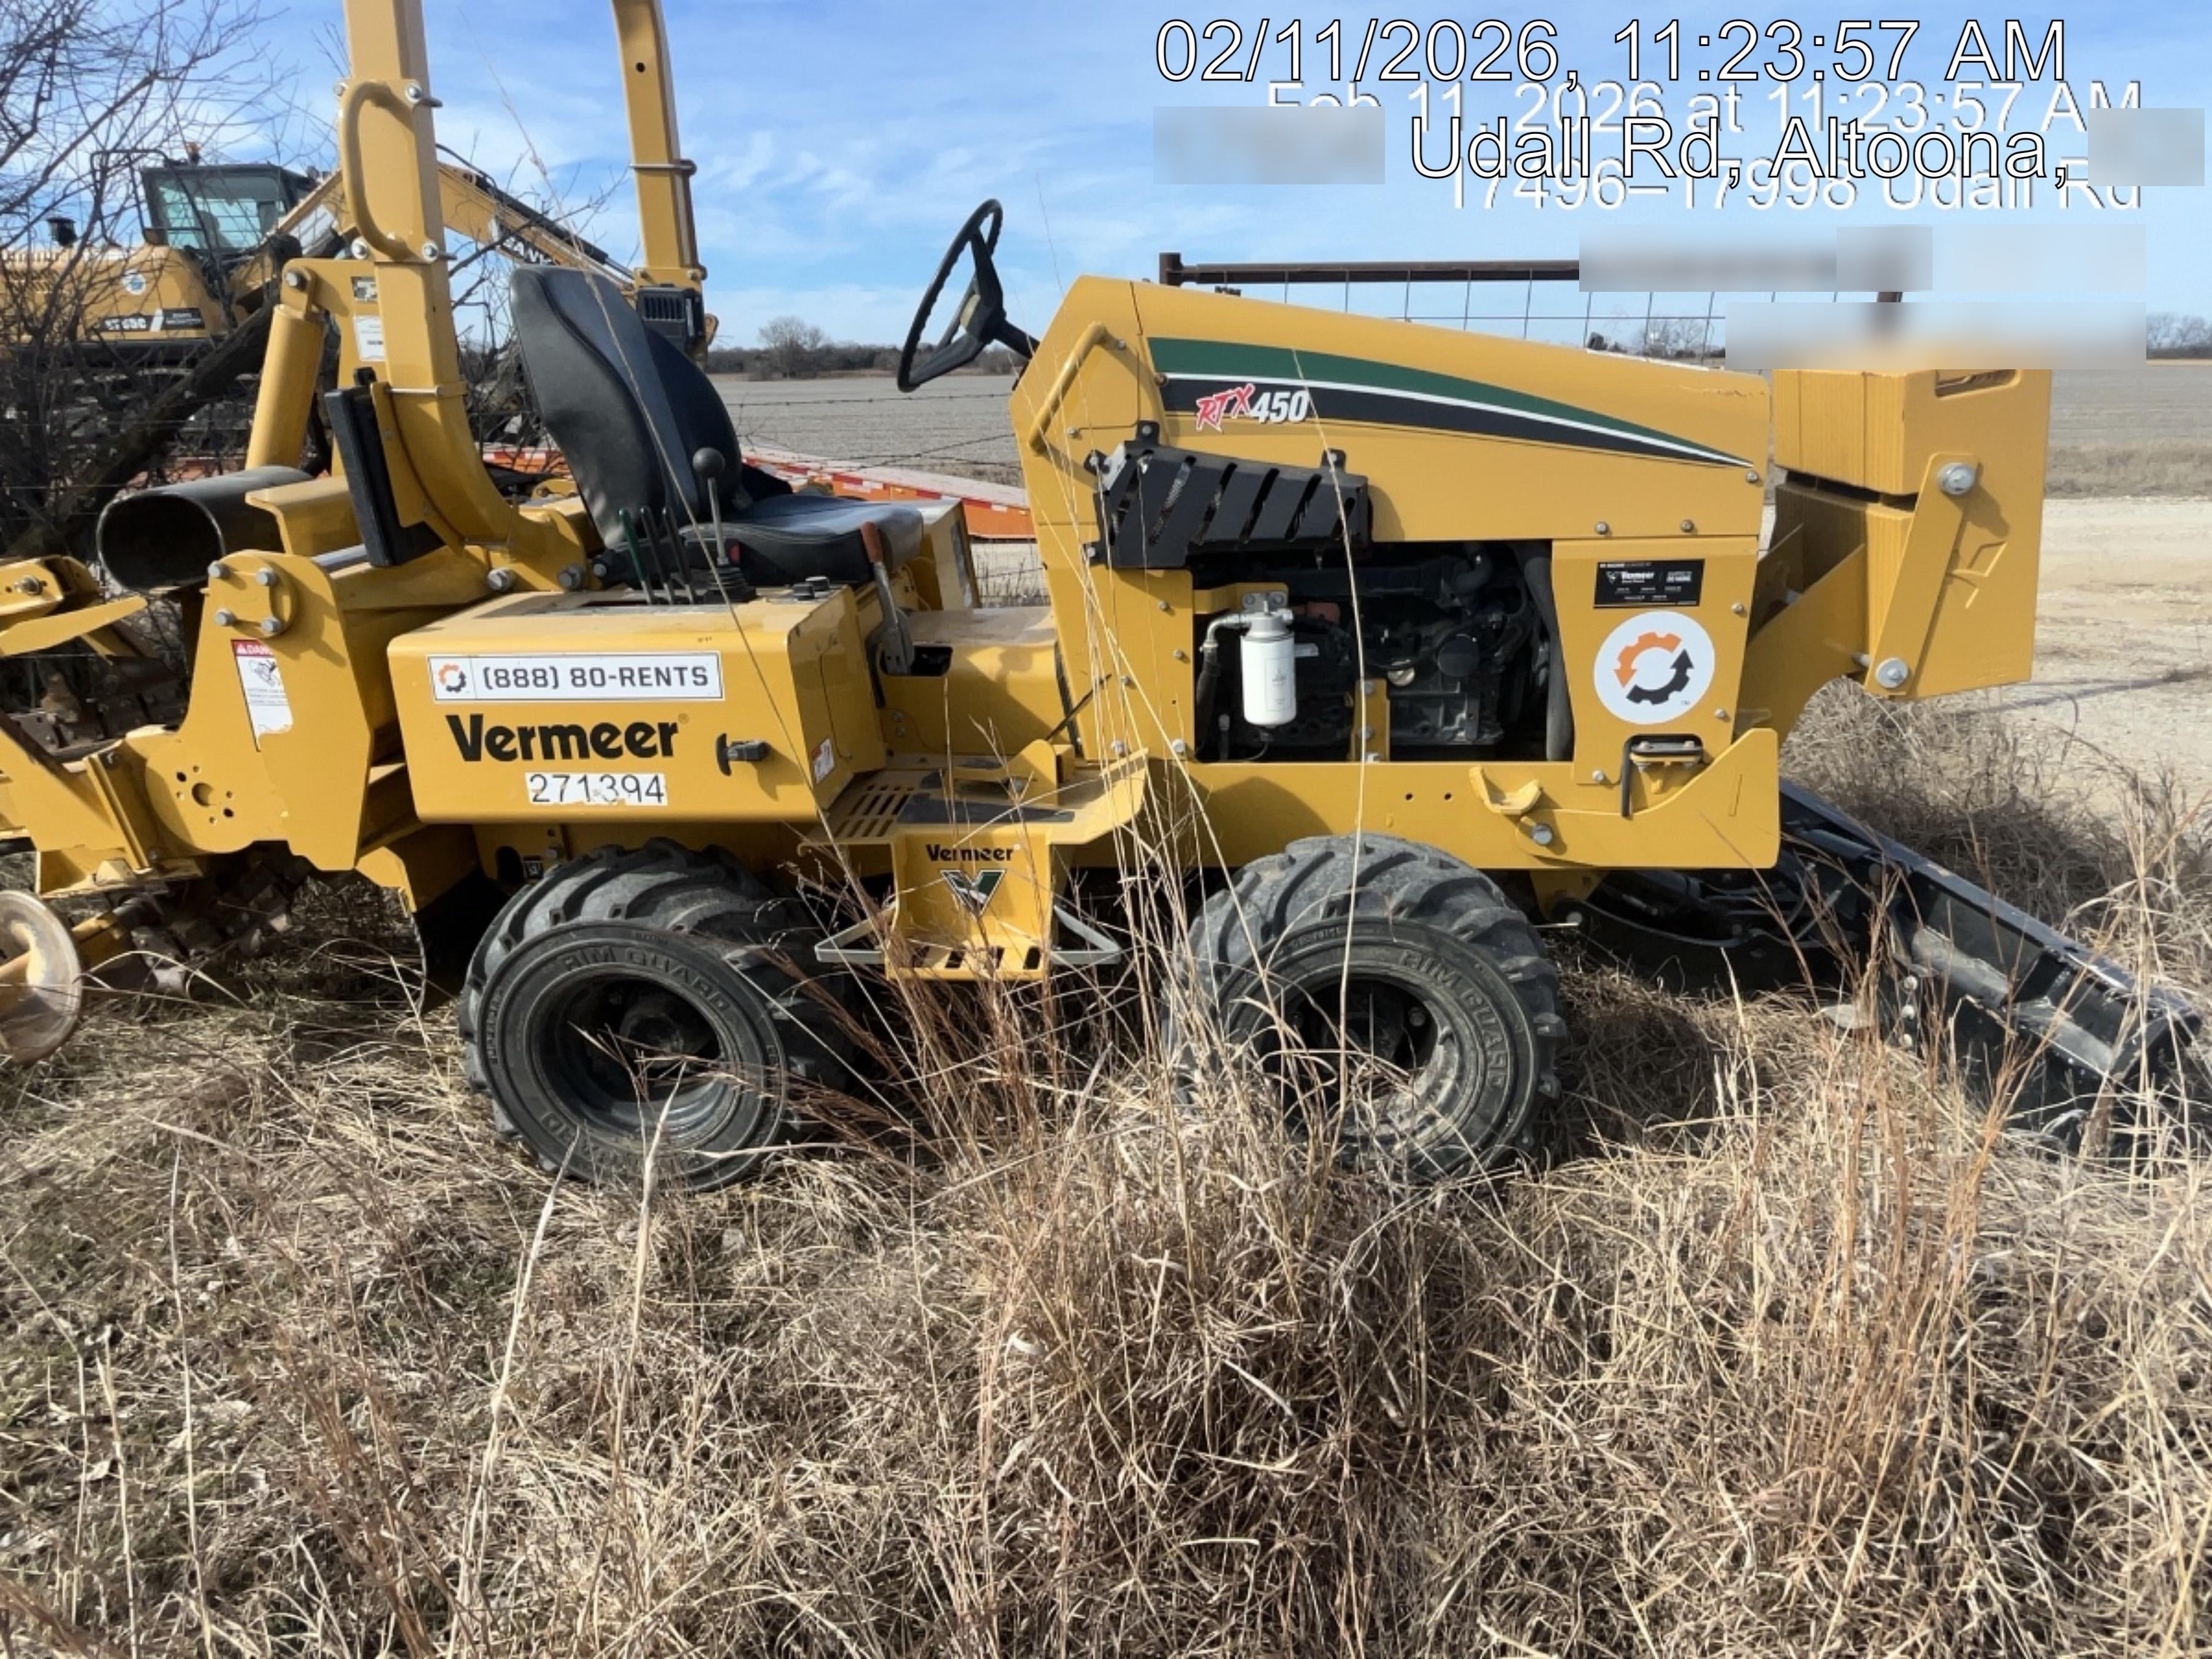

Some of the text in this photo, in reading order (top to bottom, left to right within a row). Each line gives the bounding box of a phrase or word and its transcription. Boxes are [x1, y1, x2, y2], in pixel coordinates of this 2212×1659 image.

[483, 666, 709, 689] (888) 80-RENTS
[445, 713, 679, 762] Vermeer
[530, 774, 664, 802] 271394
